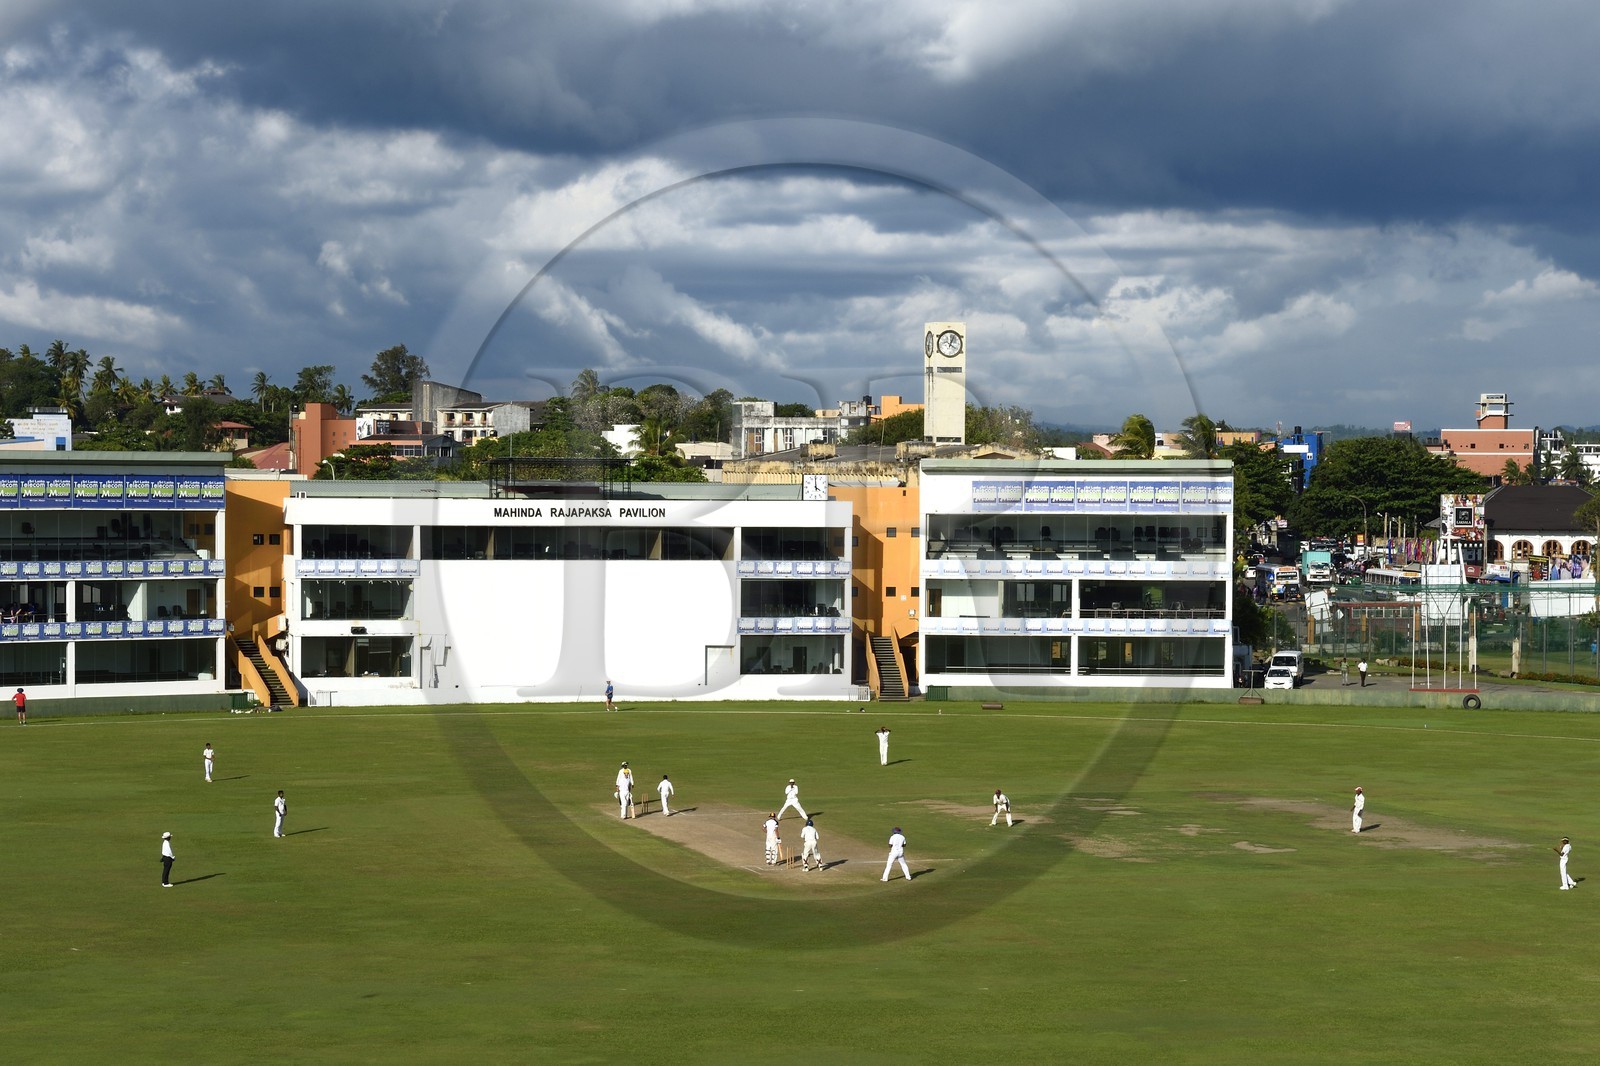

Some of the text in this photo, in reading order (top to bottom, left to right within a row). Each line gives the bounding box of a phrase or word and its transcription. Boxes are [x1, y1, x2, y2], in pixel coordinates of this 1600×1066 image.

[20, 480, 45, 488] Telecom
[46, 480, 70, 488] Telecom
[151, 481, 174, 489] Telecom
[494, 508, 666, 517] MAHINDA RAJAPAKSA PAVILION
